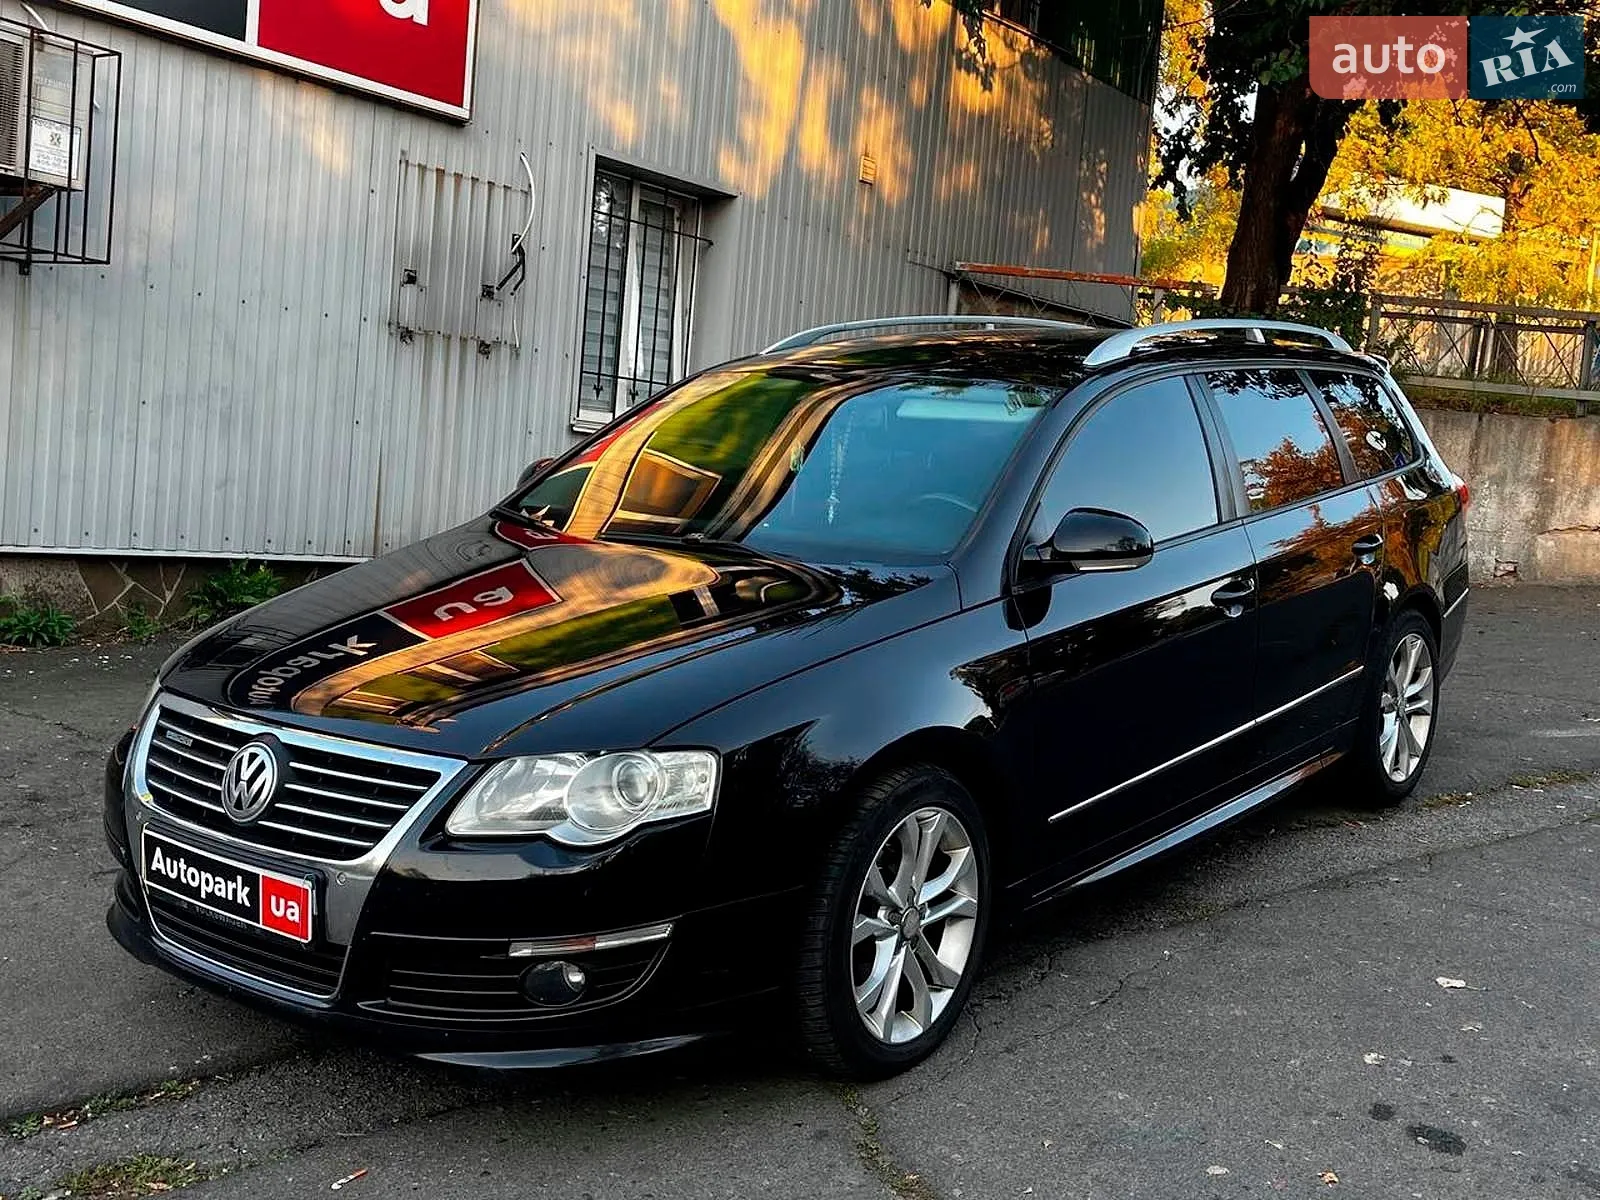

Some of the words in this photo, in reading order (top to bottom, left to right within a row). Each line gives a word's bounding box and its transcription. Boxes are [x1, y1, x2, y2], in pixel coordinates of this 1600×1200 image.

[225, 746, 273, 814] VW
[150, 846, 250, 907] Autopark
[270, 894, 301, 924] ua
